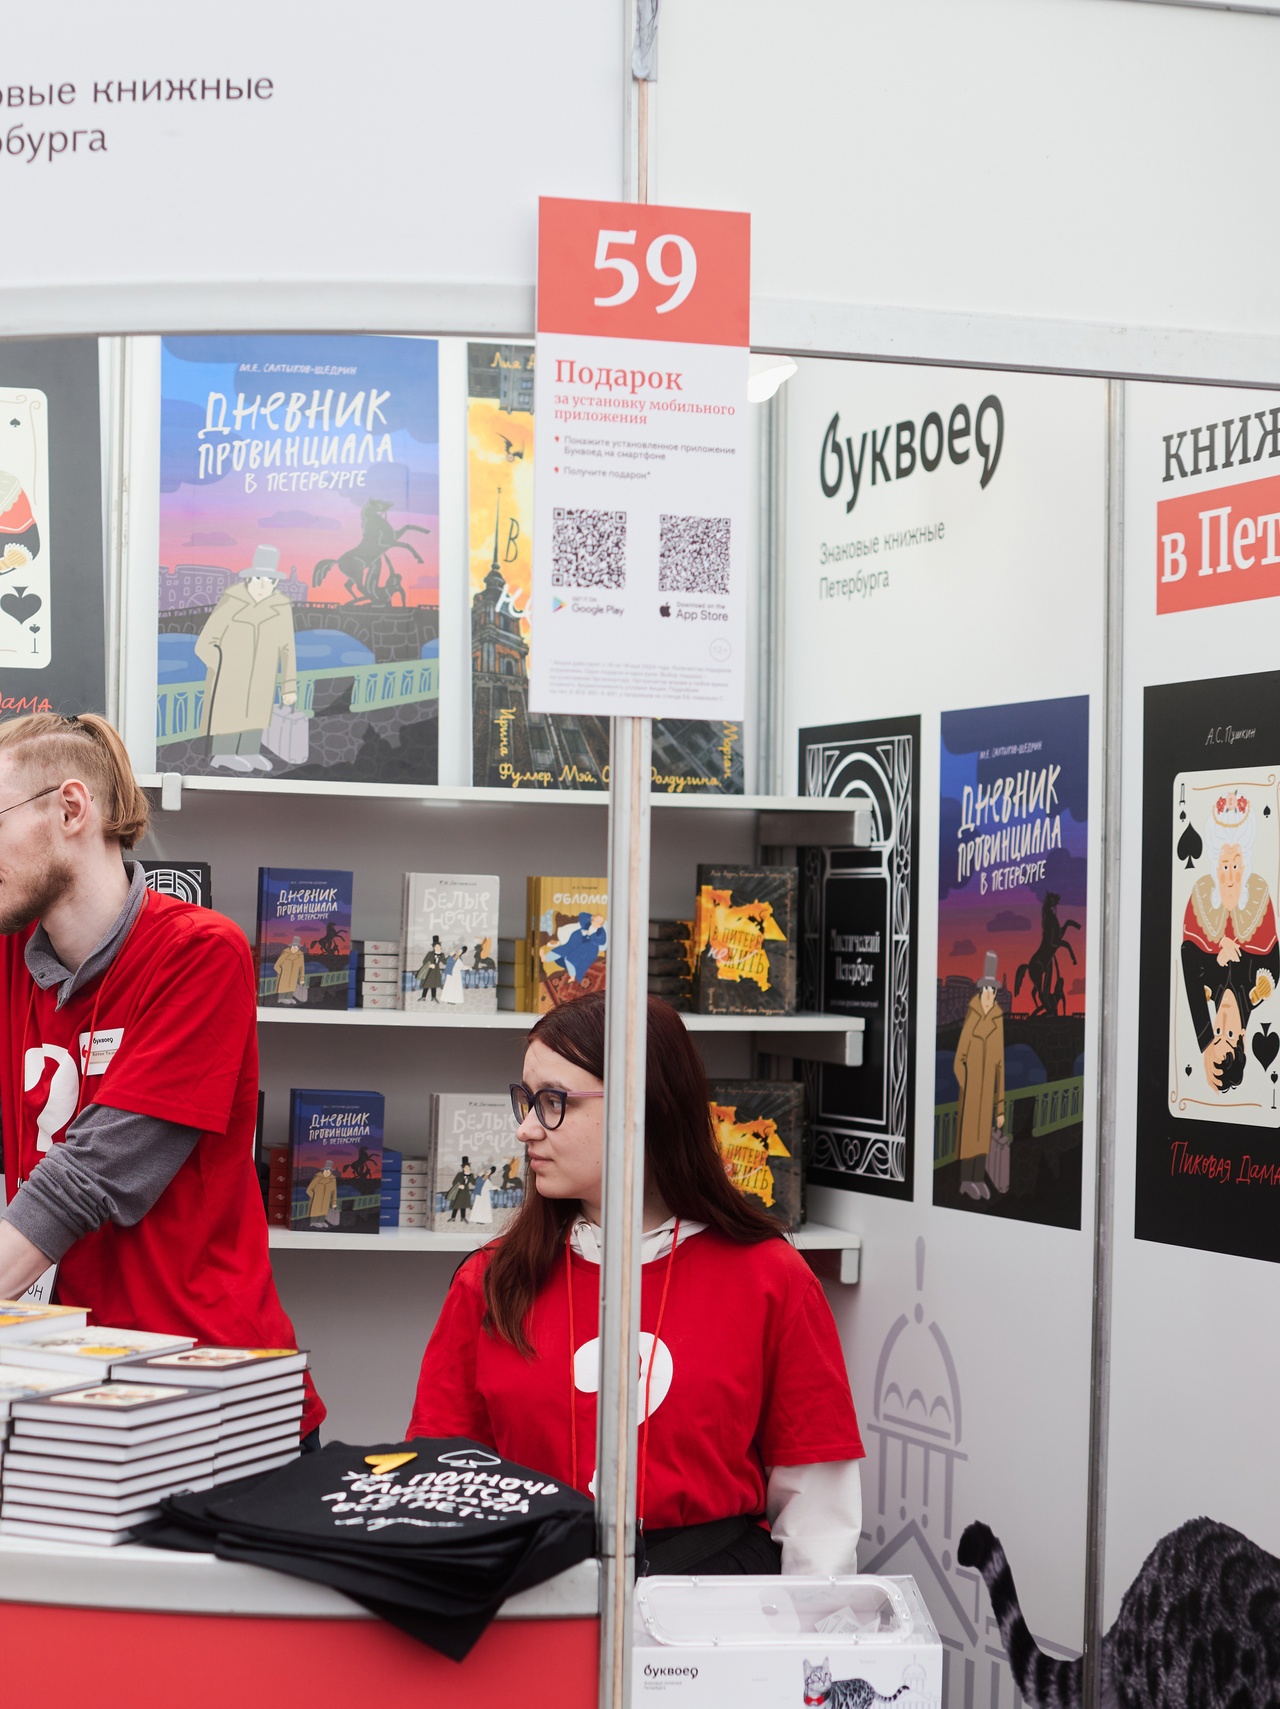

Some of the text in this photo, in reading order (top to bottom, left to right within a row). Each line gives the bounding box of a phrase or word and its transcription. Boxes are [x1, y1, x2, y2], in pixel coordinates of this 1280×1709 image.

[92, 72, 275, 104] книжные
[594, 229, 697, 314] 59
[239, 362, 358, 376] М.Е. САЛТЫКОВ-ЩЕДРИН
[554, 358, 683, 395] Подарок
[197, 388, 392, 439] ДНЕВНИК
[554, 393, 736, 417] за установку мобильного
[554, 407, 648, 425] приложения
[198, 433, 395, 480] ПРОВИНЦИАЛА
[563, 446, 667, 463] Буквоед на смартфоне
[564, 434, 736, 457] Покажите установленное приложение
[820, 394, 1005, 514] буквоед
[244, 470, 367, 494] В ПЕТЕРБУРГЕ
[563, 465, 607, 479] Получите
[503, 517, 520, 563] В
[819, 520, 946, 566] Знаковые книжные
[1160, 531, 1188, 584] в
[819, 567, 890, 602] Петербурга
[571, 602, 624, 617] Google Play
[676, 608, 729, 622] App Store
[957, 763, 1062, 839] ДНЕВНИК
[957, 814, 1062, 883] ПРОВИНЦИАЛА
[980, 860, 1047, 896] В ПЕТЕРБУРГЕ
[276, 887, 339, 907] ДНЕВНИК
[422, 886, 490, 914] БЕЛЫЕ
[276, 901, 339, 918] ПРОВИНЦИАЛА
[428, 909, 489, 932] НОЧИ
[722, 928, 764, 950] ПИТЕРЕ
[309, 1112, 370, 1129] ДНЕВНИК
[308, 1125, 370, 1142] ПРОВИНЦИАЛА
[726, 1143, 768, 1166] ПИТЕРЕ
[408, 1470, 560, 1496] ПОЛНОЧЬ
[643, 1663, 699, 1680] буквоед
